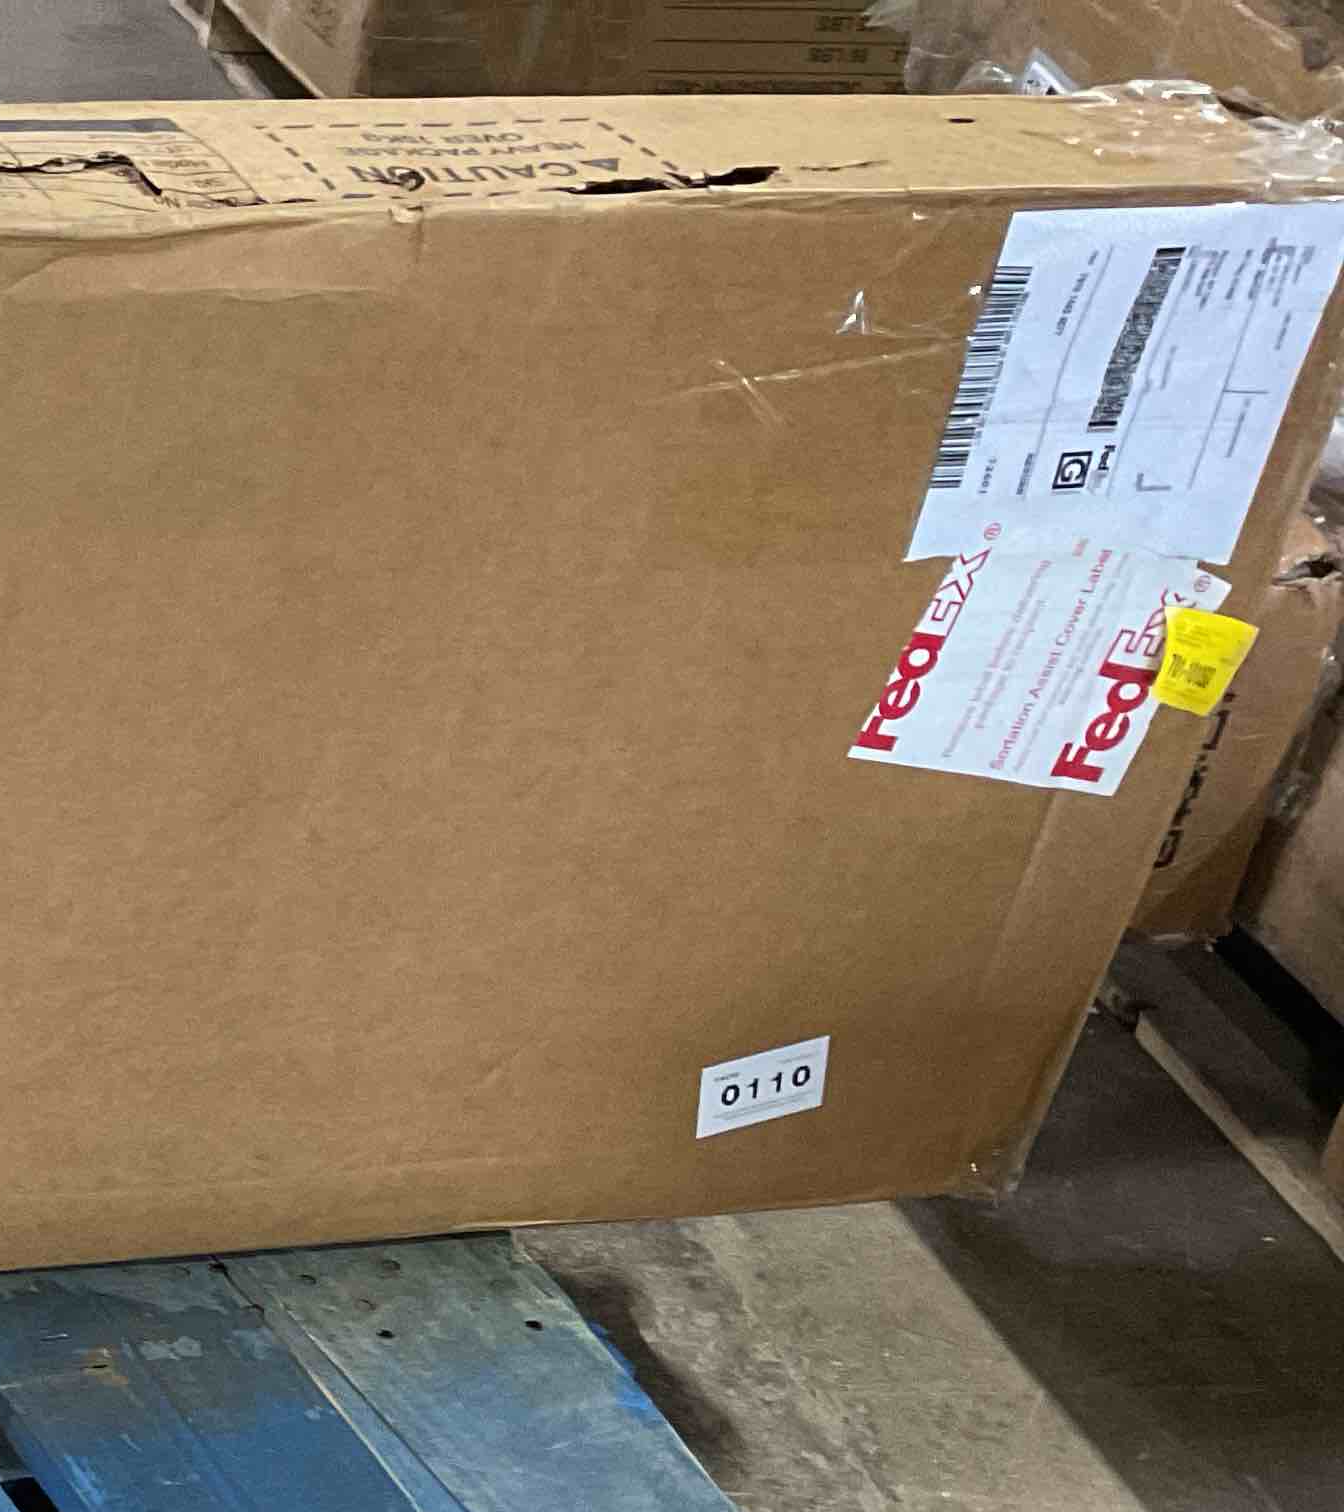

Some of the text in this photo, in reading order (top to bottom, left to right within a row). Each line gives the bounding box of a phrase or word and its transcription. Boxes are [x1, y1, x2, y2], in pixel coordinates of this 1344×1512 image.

[1054, 597, 1088, 647] Cover
[853, 546, 993, 752] FedEx
[720, 1064, 811, 1107] 0110
